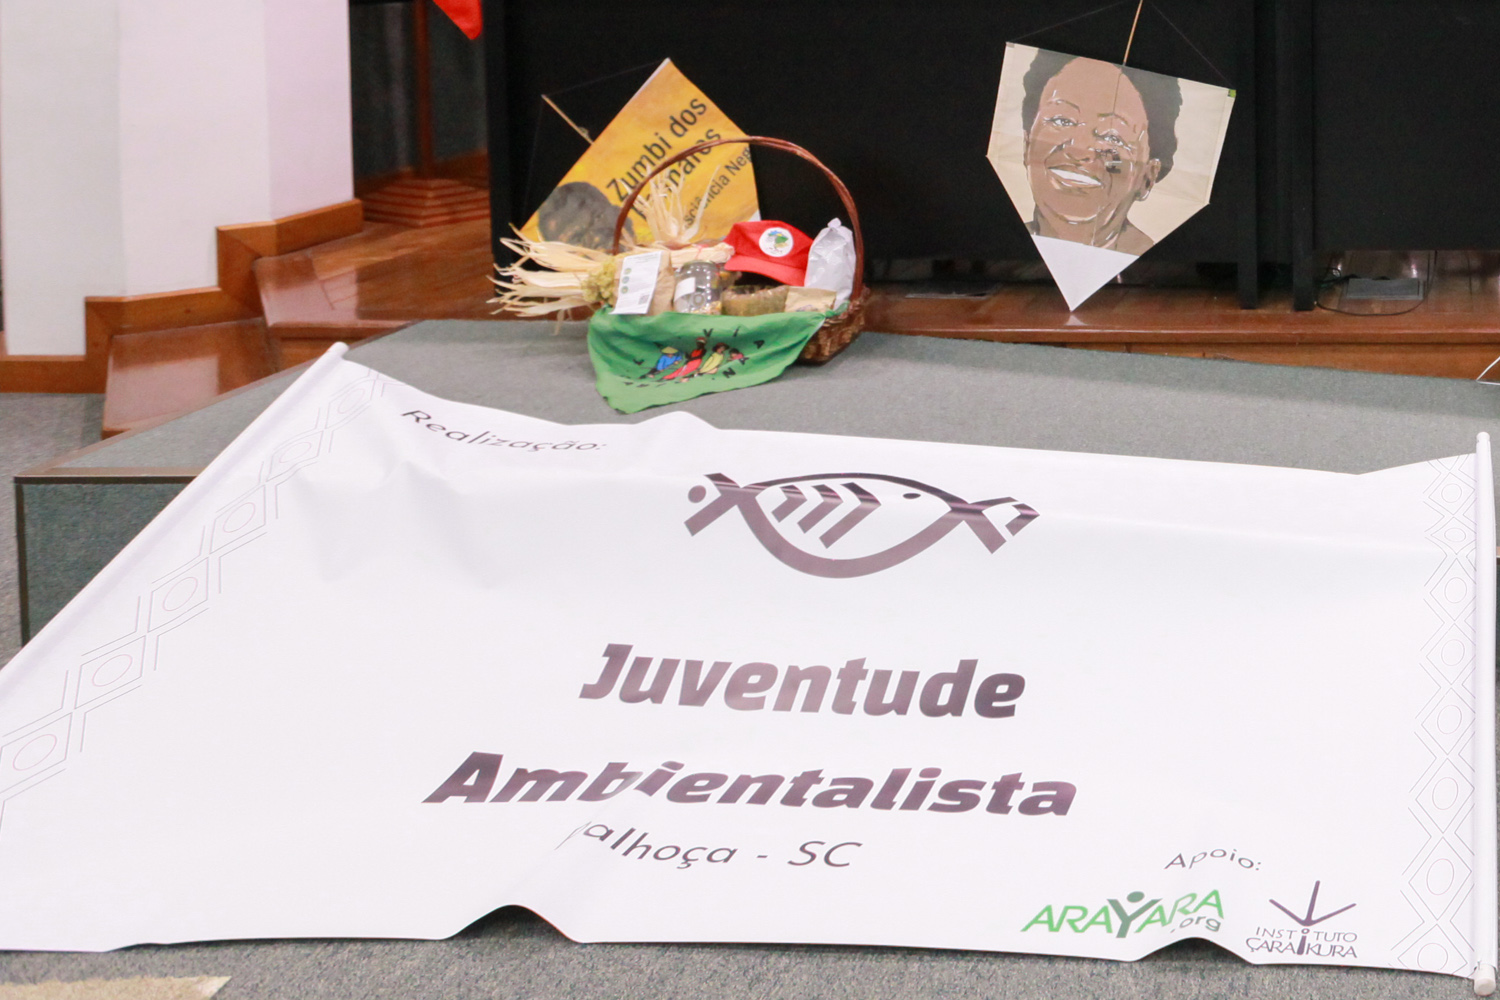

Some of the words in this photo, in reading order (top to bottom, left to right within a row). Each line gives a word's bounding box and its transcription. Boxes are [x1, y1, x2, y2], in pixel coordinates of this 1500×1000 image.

[606, 132, 672, 203] Zumbi
[669, 98, 708, 138] dos
[724, 146, 753, 177] Neg
[401, 409, 607, 453] Realização:
[578, 642, 1026, 719] Juventude
[420, 750, 1079, 817] Ambientalista
[787, 840, 864, 868] SC
[1163, 848, 1262, 871] Apoio:
[1020, 889, 1225, 939] ARAYARA
